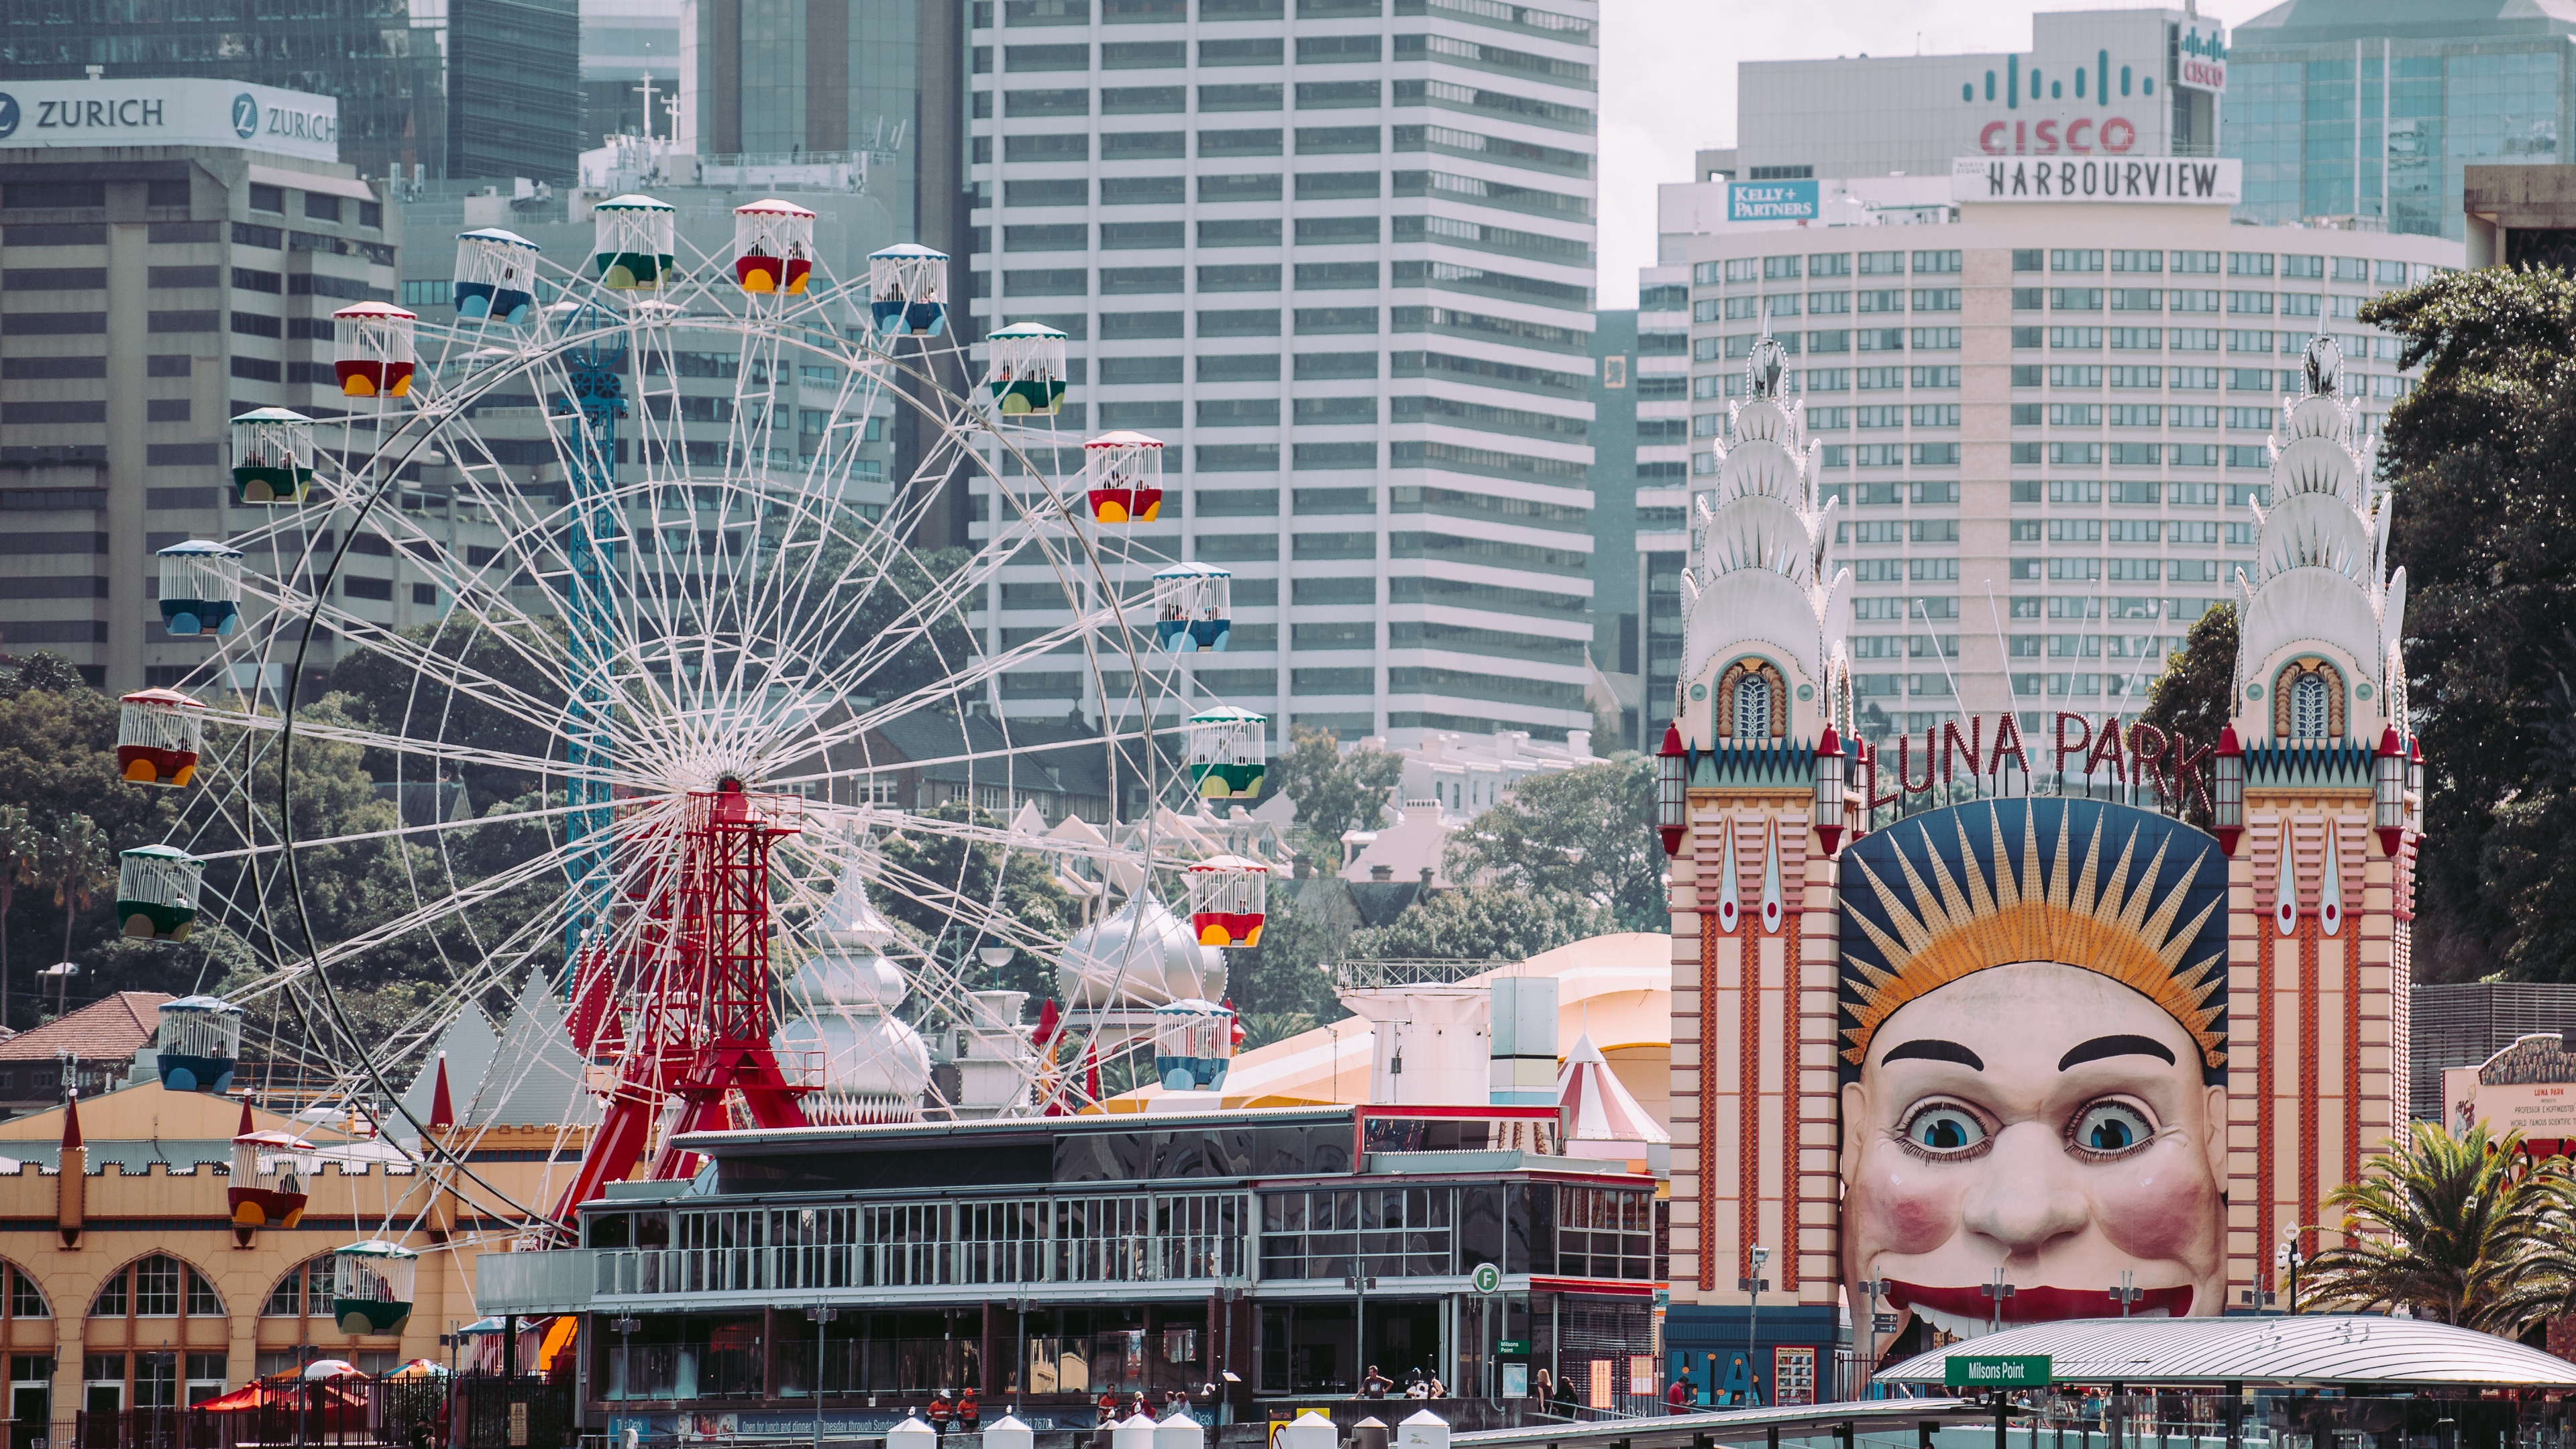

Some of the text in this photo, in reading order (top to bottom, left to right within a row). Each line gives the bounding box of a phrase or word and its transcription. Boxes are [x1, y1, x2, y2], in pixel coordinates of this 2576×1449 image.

[2184, 60, 2223, 87] CISCO
[37, 99, 164, 127] ZURICH
[267, 106, 337, 142] ZURICH
[1980, 116, 2136, 156] CISCO
[1986, 161, 2218, 197] HARBOURVIEW
[1734, 202, 1813, 217] PARTNERS
[1867, 710, 2212, 813] LUNA PARK
[2514, 1106, 2540, 1114] PROFESSOR
[2530, 1118, 2547, 1126] FAMOUS
[2548, 1118, 2571, 1126] SCIENTIFIC
[1483, 1271, 1493, 1287] F
[1968, 1361, 2025, 1379] Milsons Point
[742, 1421, 756, 1433] Open
[757, 1421, 765, 1432] for
[765, 1421, 780, 1432] lunch
[780, 1421, 791, 1432] and
[792, 1421, 812, 1432] dinner
[849, 1420, 872, 1431] through
